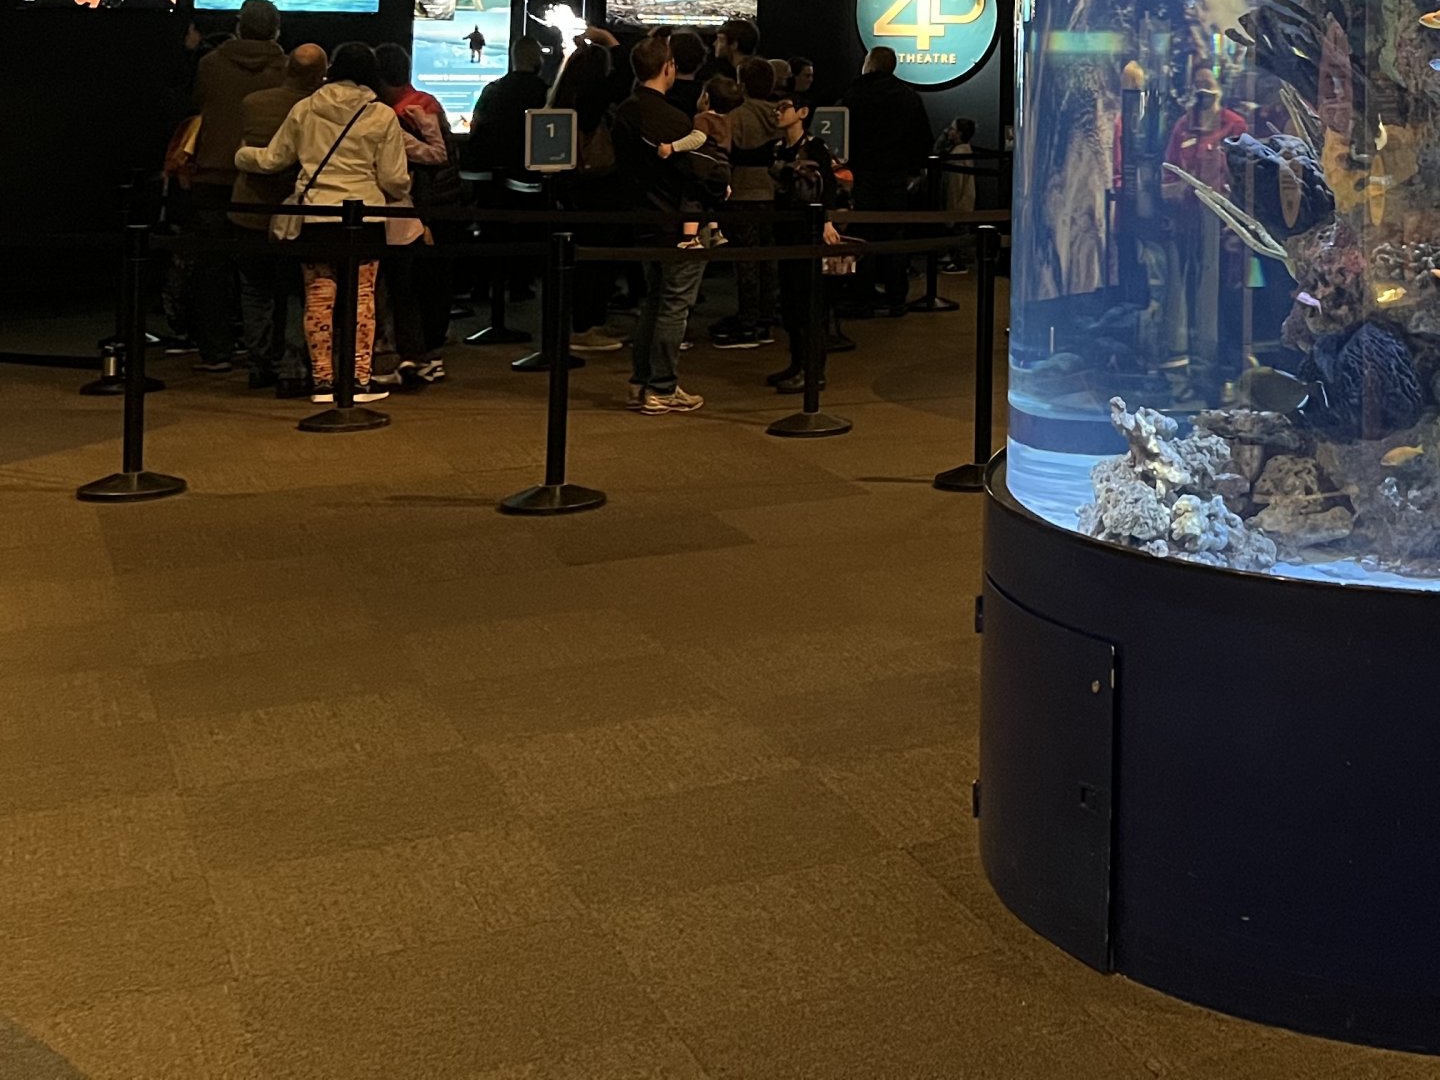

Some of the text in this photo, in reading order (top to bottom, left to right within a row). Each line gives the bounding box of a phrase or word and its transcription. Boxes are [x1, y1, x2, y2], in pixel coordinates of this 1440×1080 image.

[899, 53, 957, 64] THEATRE
[546, 123, 556, 138] 1
[821, 120, 831, 134] 2
